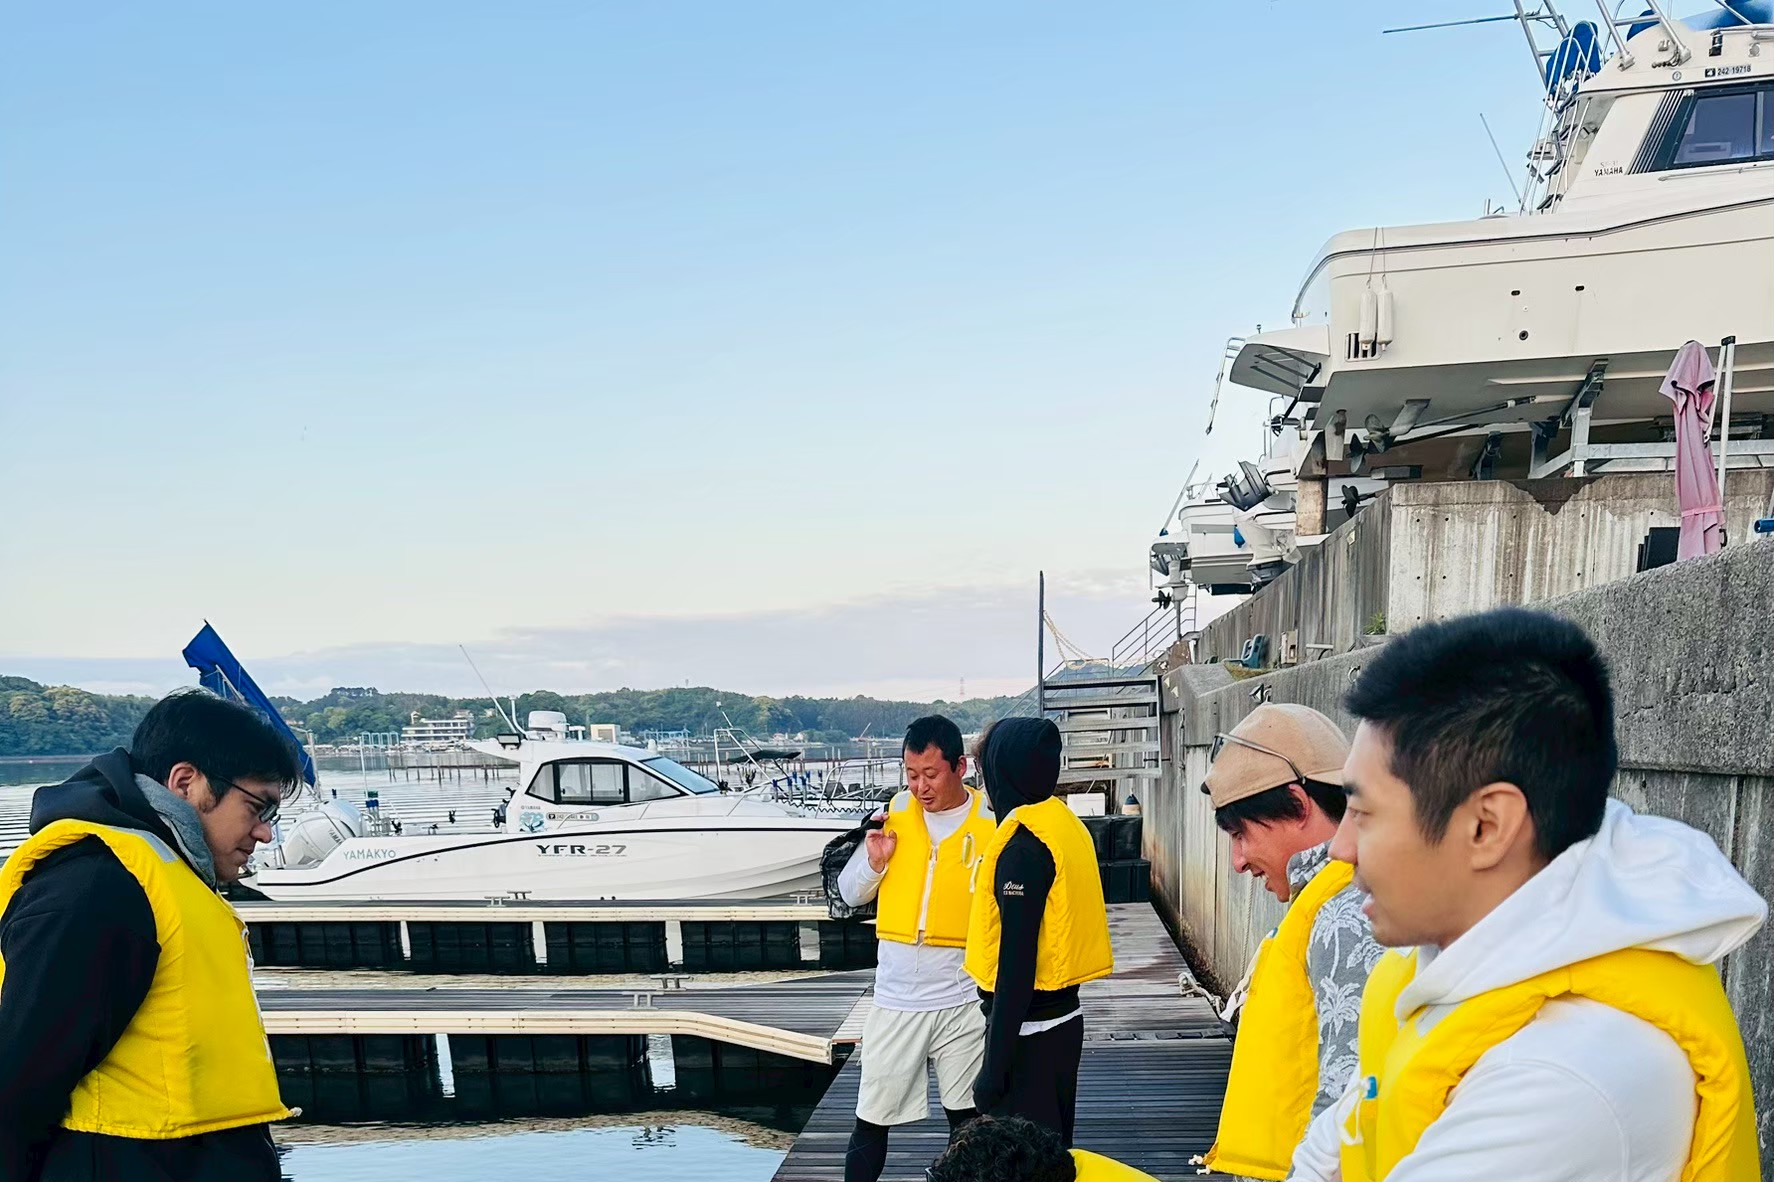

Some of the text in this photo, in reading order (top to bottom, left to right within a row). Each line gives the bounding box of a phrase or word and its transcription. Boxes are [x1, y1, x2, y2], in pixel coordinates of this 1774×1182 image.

[1594, 167, 1623, 176] YAMAHA
[343, 848, 397, 860] YAMAKYO
[536, 844, 627, 855] YFR-27
